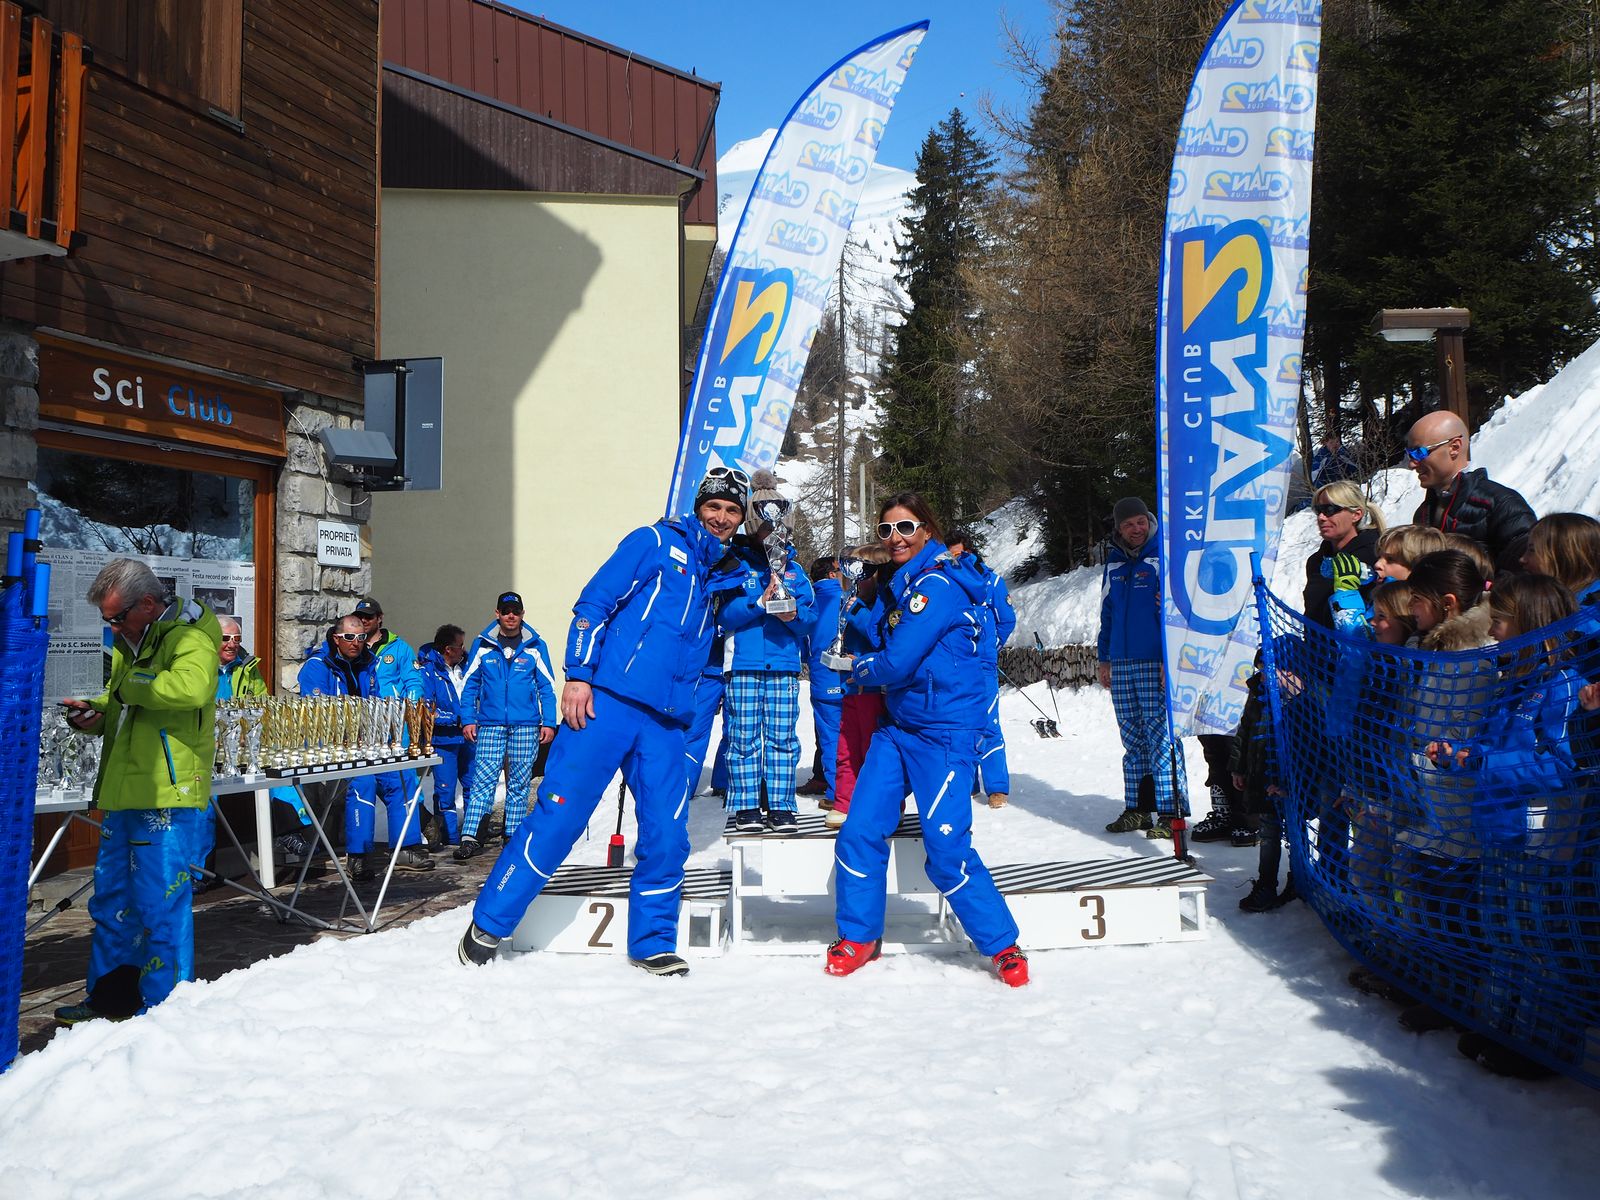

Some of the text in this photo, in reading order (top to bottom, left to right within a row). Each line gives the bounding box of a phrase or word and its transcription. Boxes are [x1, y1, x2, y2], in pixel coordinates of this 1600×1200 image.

[93, 367, 233, 426] Sci Club
[325, 545, 353, 558] PRIVATA
[232, 574, 243, 582] baby
[588, 902, 614, 947] 2
[1080, 895, 1106, 940] 3
